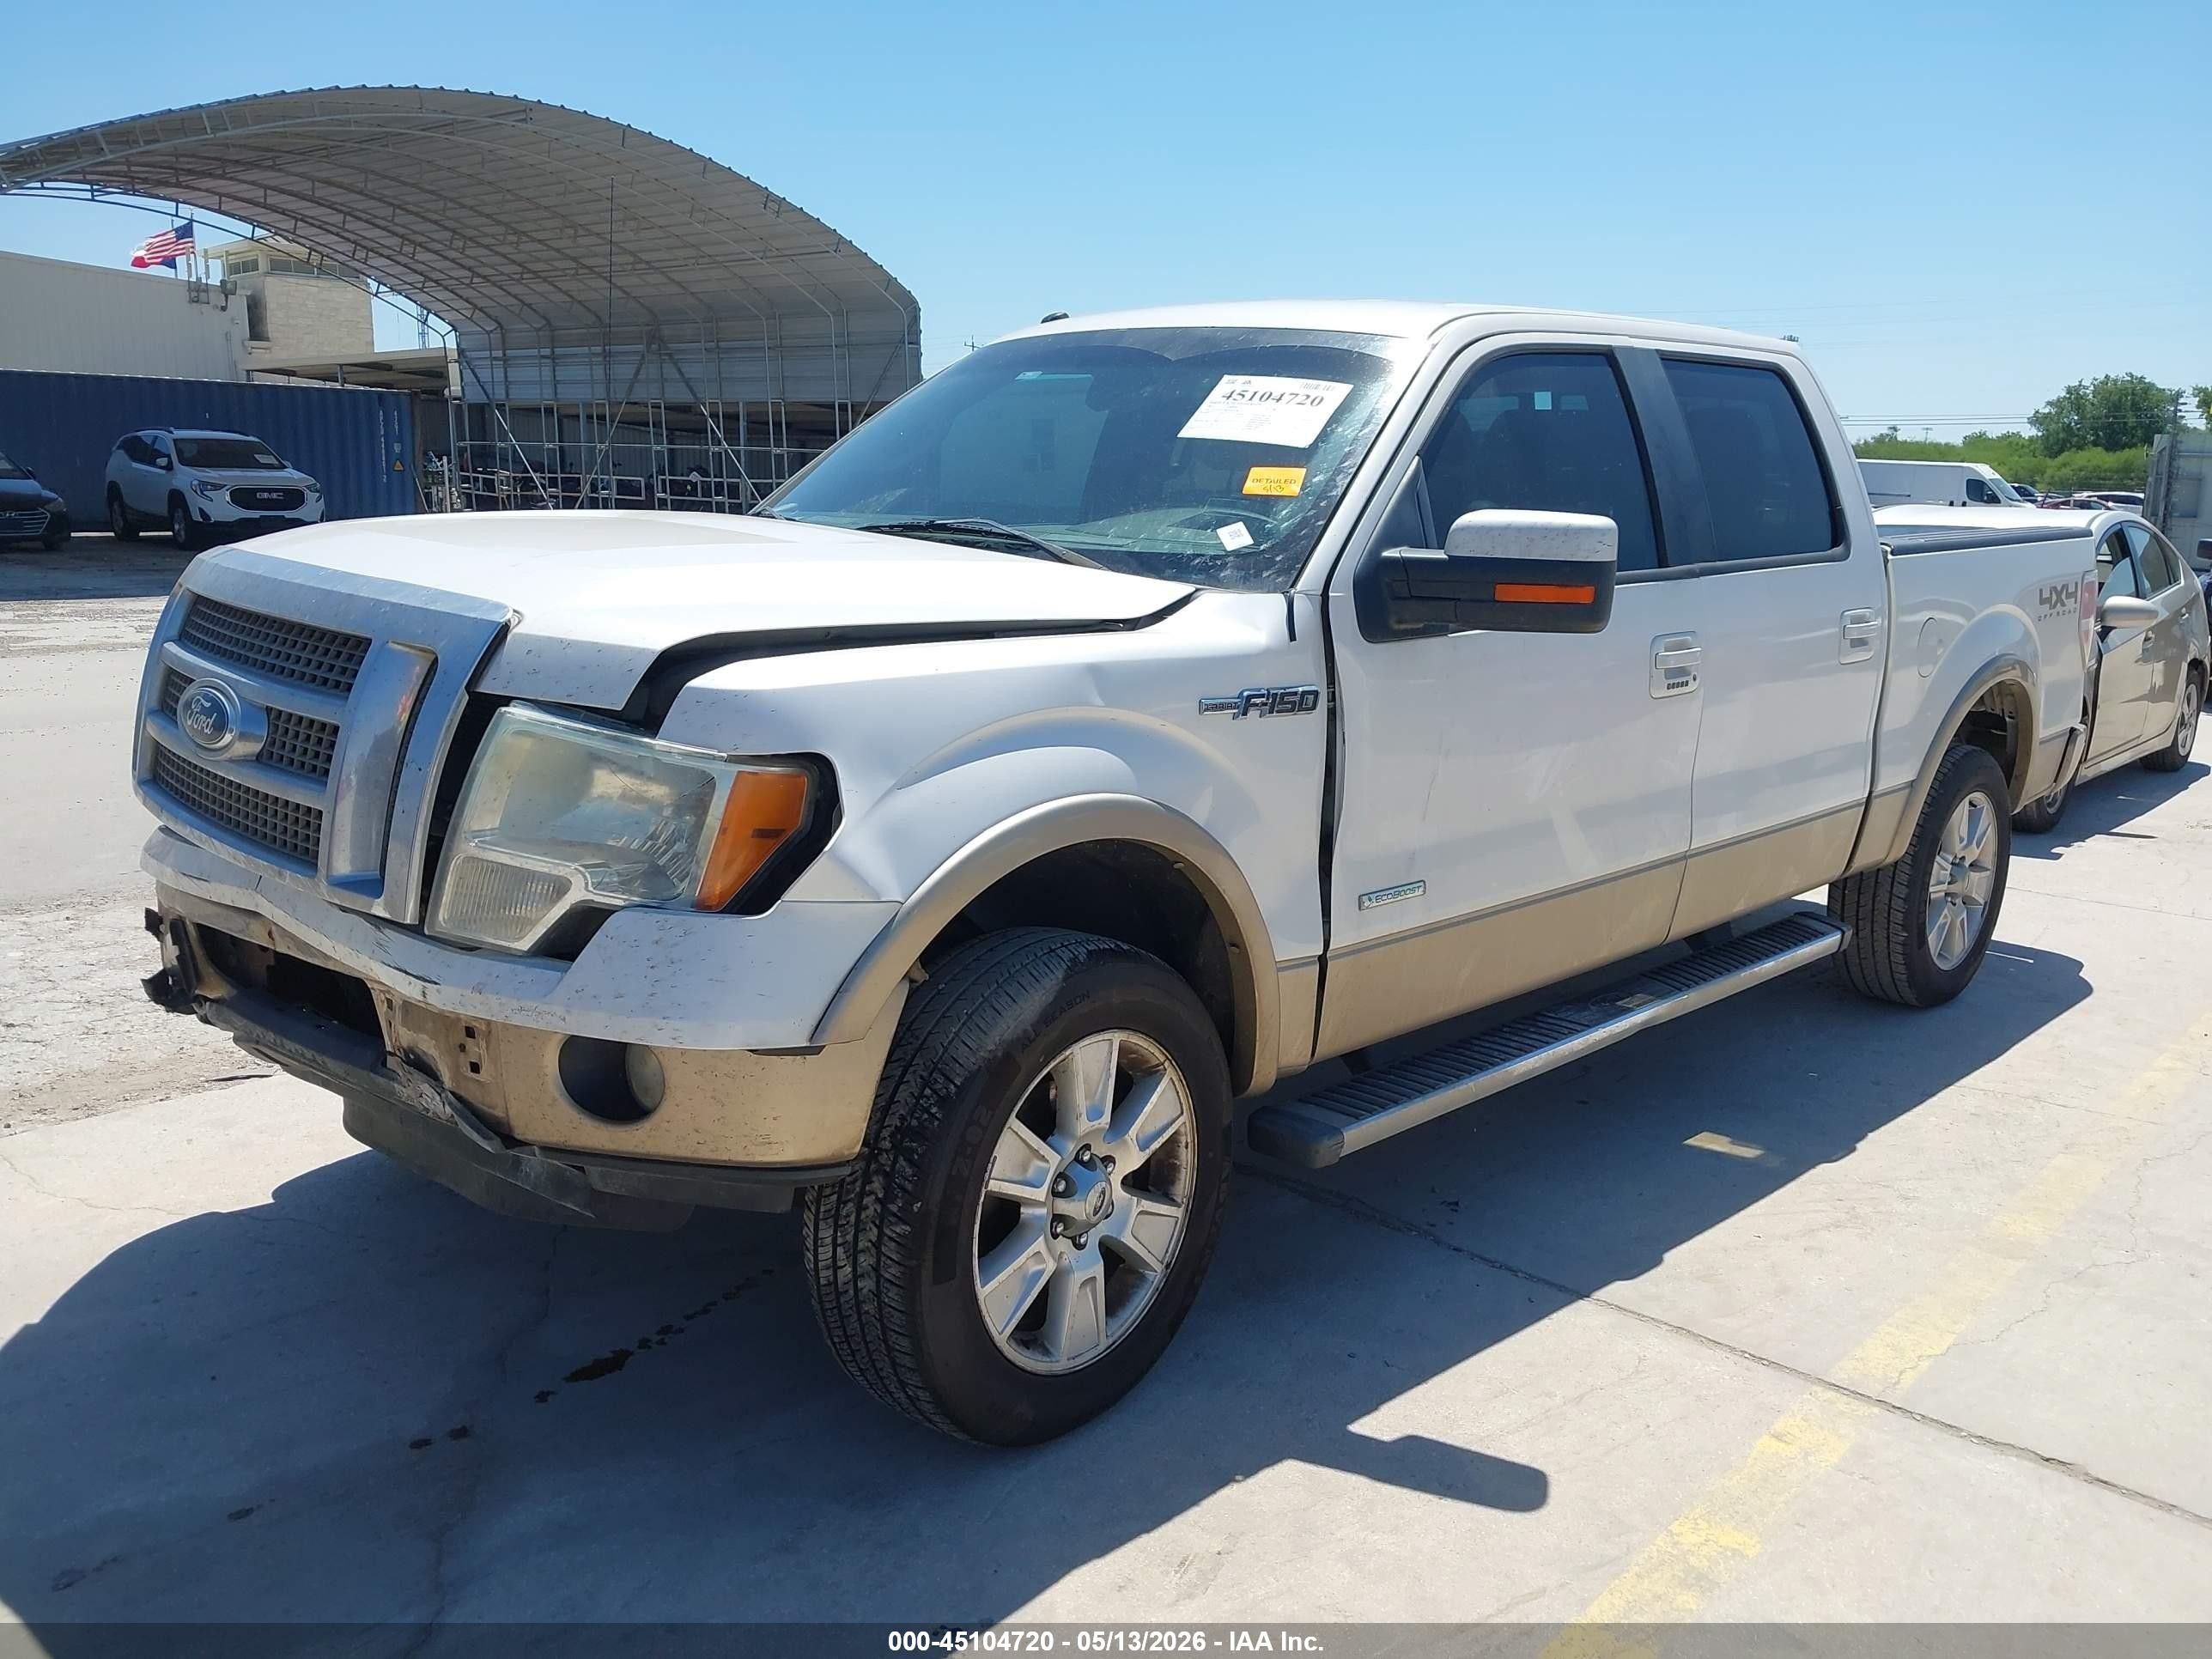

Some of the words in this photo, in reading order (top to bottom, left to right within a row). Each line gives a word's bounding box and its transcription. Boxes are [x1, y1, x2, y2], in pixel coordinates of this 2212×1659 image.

[1222, 389, 1324, 406] 45104720
[186, 696, 216, 734] Ford
[1235, 686, 1321, 719] F-150
